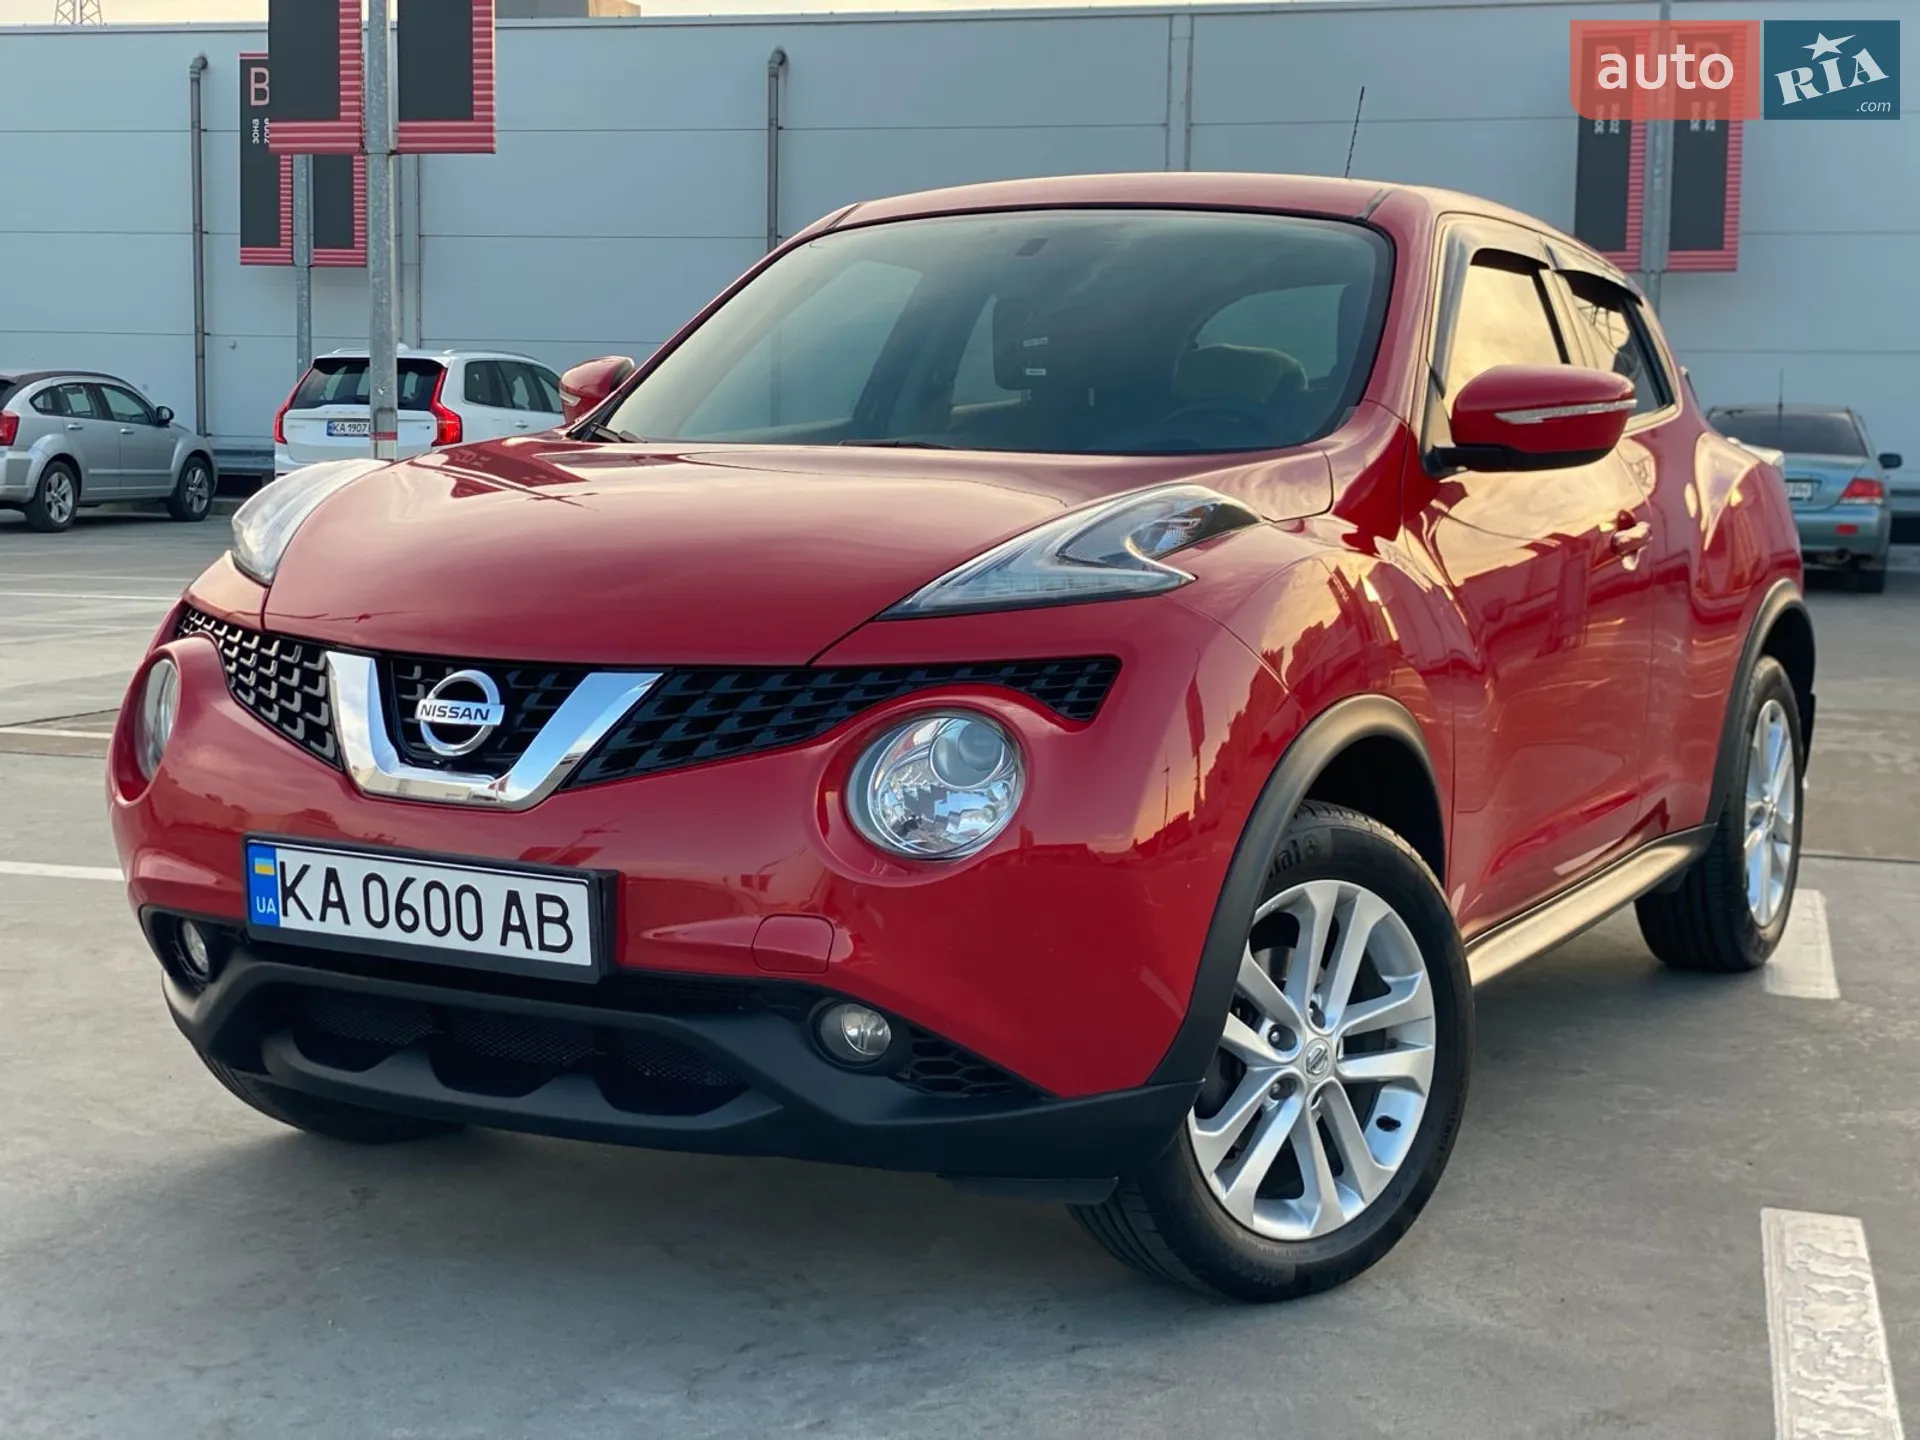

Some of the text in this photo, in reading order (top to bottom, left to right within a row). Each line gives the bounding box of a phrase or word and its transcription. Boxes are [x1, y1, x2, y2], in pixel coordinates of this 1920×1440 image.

[250, 67, 270, 106] B
[348, 423, 366, 433] 1907
[420, 702, 490, 721] NISSAN
[256, 895, 277, 915] UA
[279, 860, 574, 954] KA 0600 AB
